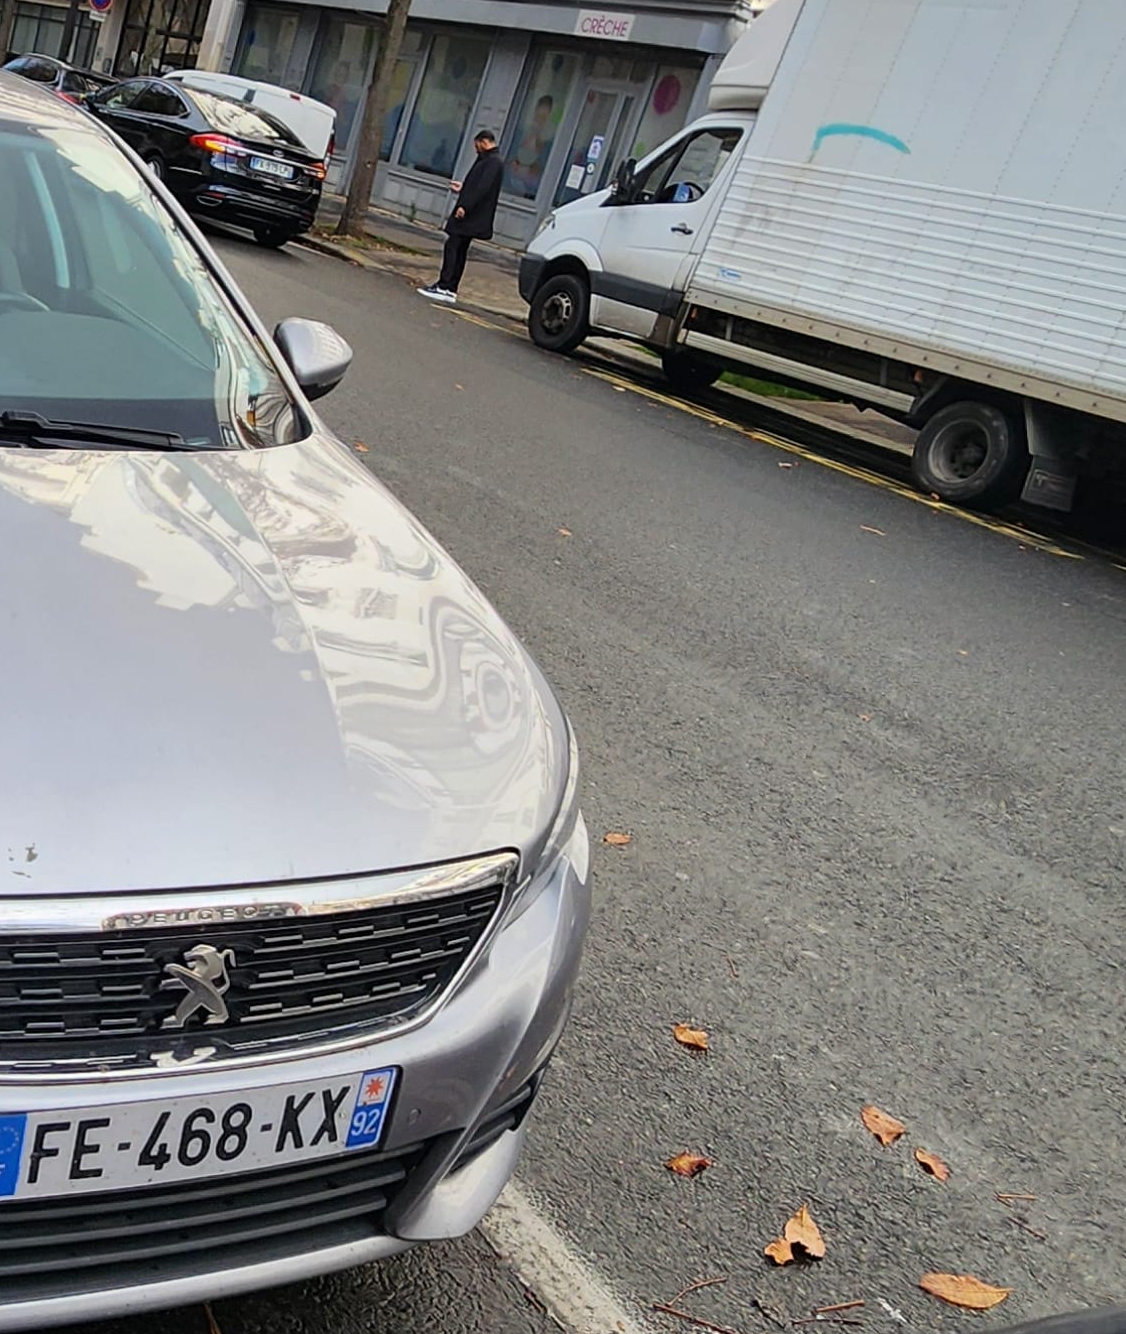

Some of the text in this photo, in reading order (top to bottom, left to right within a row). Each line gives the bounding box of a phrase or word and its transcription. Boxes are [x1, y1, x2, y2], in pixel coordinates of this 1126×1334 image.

[581, 14, 629, 37] CRÈCHE
[27, 1085, 351, 1184] FE-468-KX
[350, 1108, 381, 1137] 92
